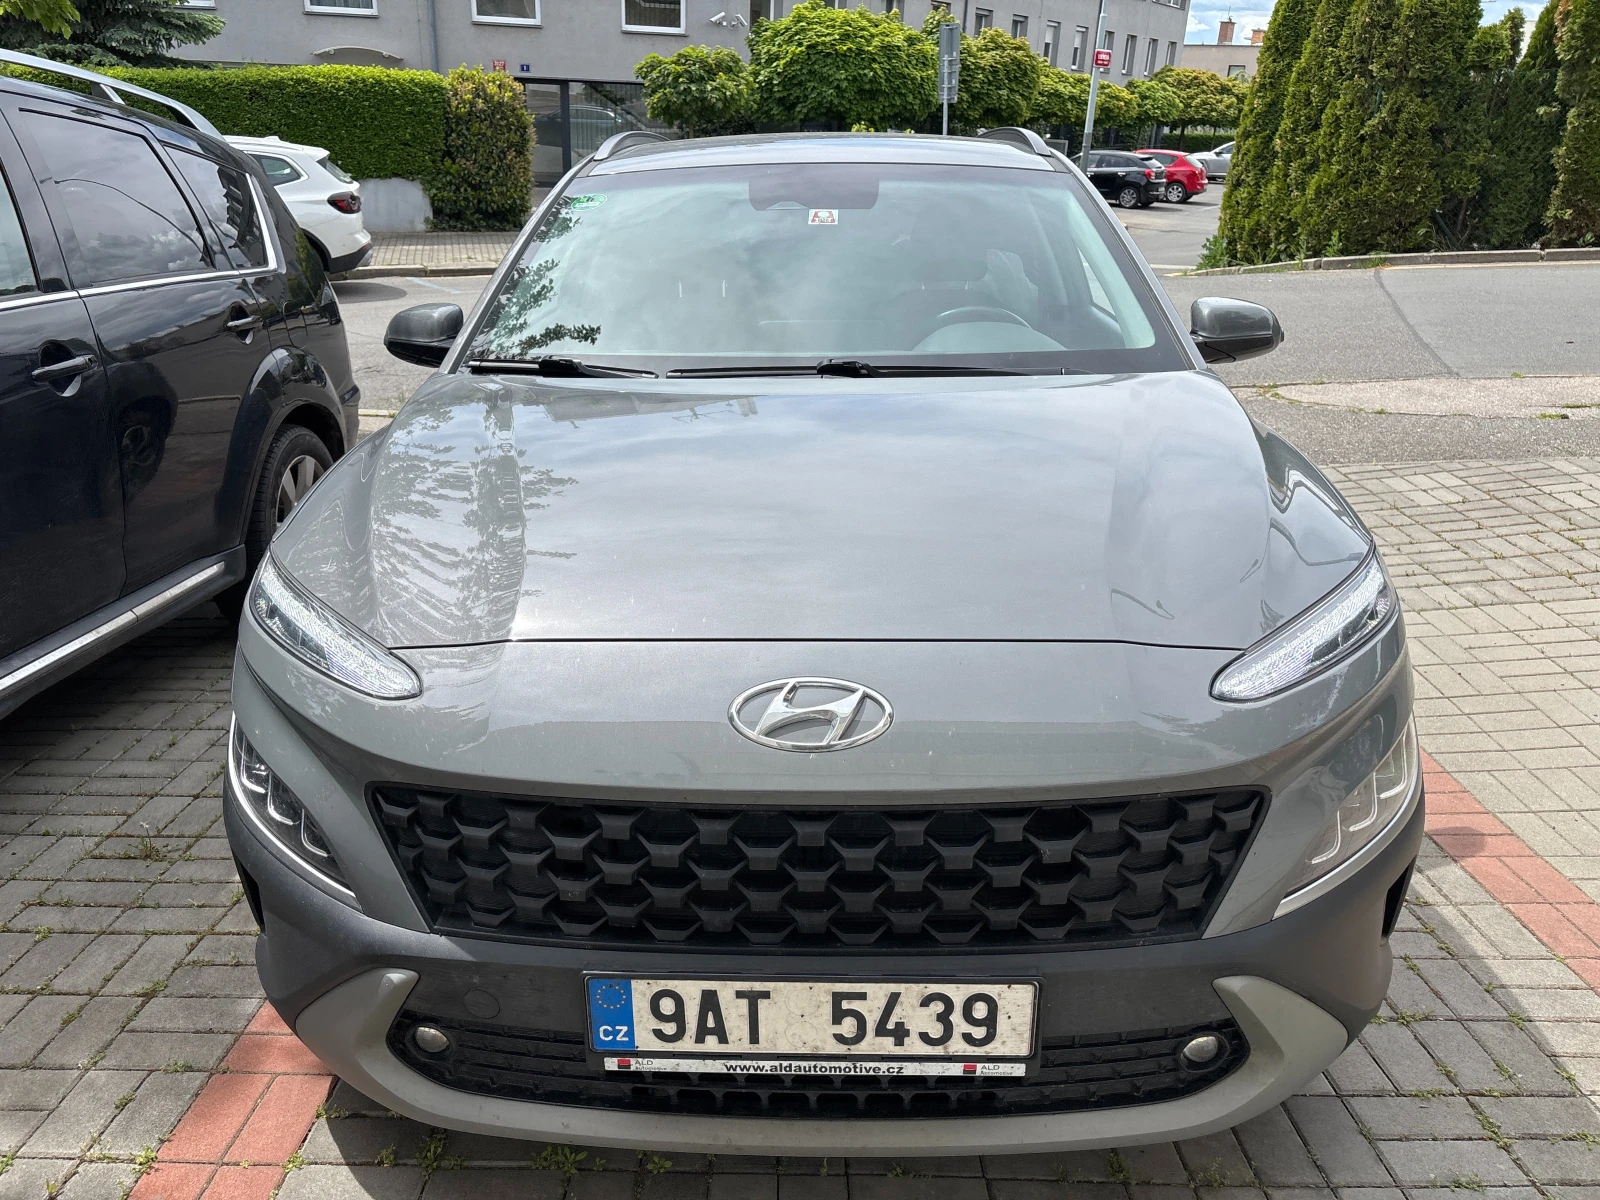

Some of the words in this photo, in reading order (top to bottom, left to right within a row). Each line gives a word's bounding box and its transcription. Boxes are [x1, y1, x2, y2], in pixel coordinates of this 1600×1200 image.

[650, 988, 771, 1044] 9AT
[831, 991, 999, 1047] 5439
[599, 1025, 629, 1041] CZ
[724, 1062, 905, 1075] www.aldautomotive.cz
